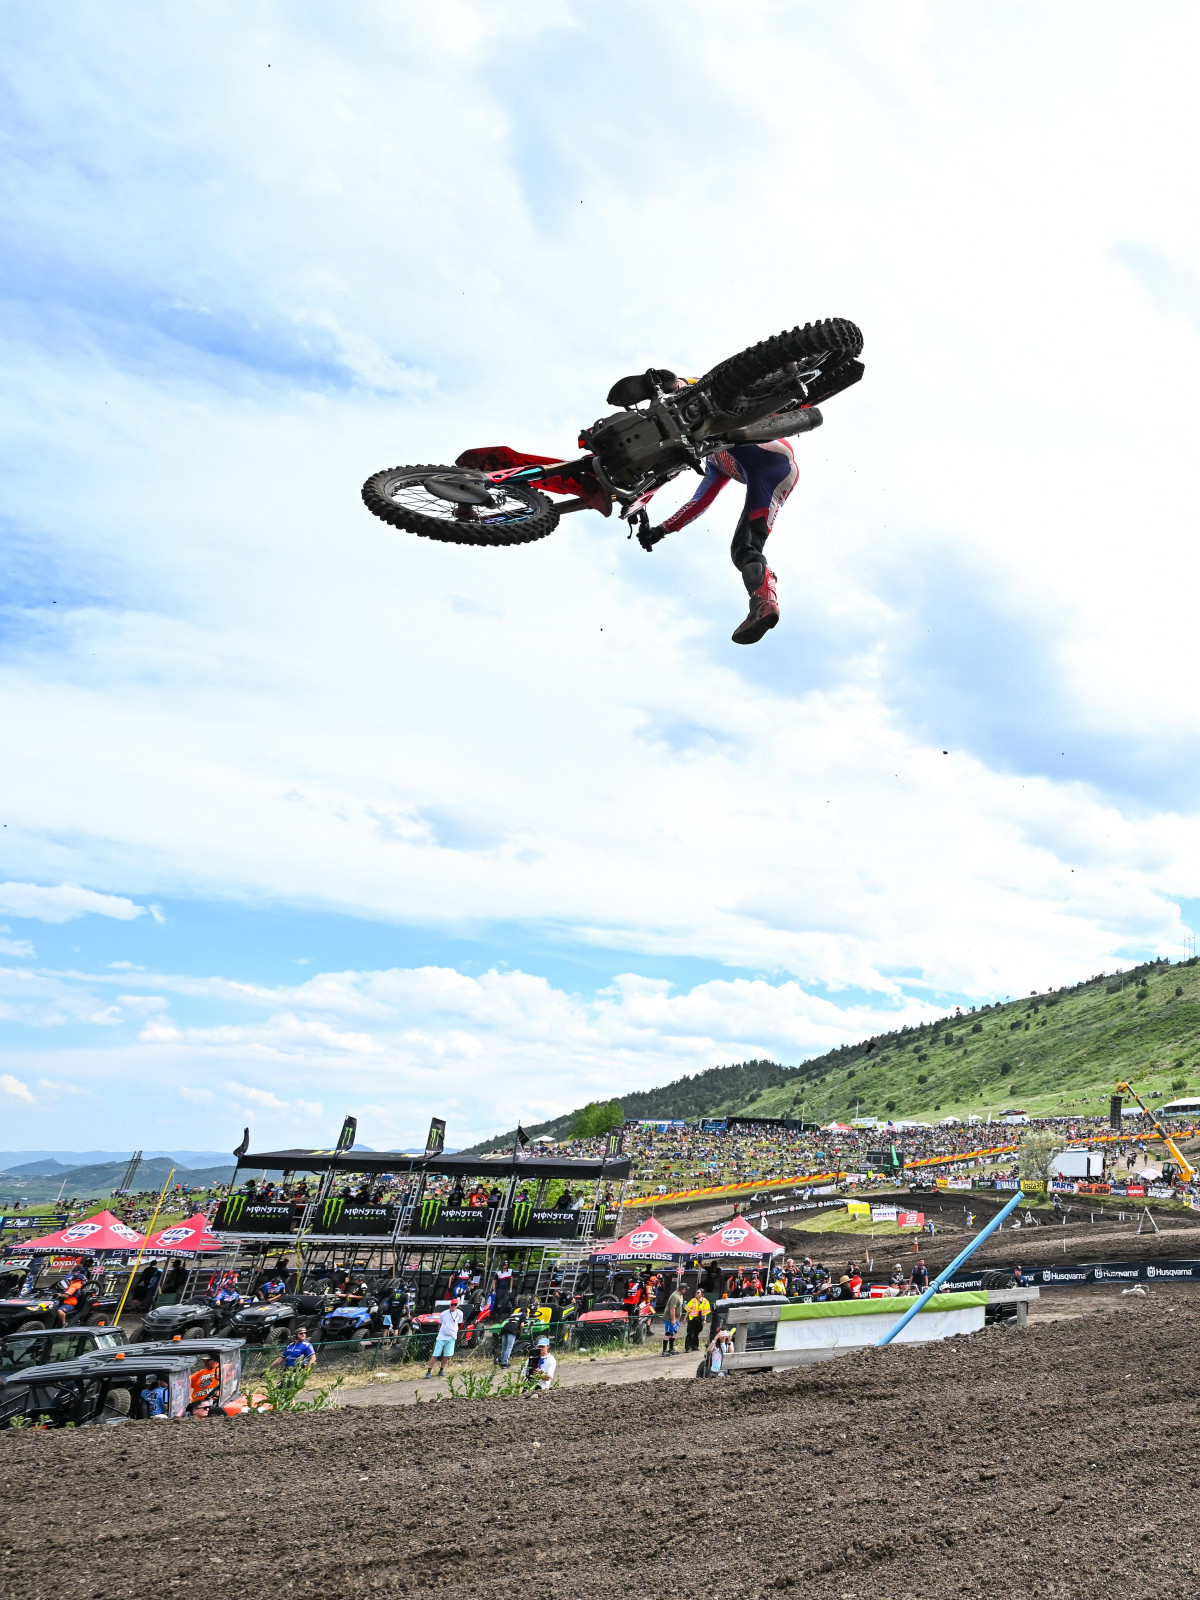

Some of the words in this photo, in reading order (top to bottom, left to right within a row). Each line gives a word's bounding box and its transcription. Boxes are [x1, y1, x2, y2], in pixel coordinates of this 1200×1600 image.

[1052, 1181, 1075, 1190] PARTS
[246, 1205, 289, 1214] MONSTER
[344, 1208, 387, 1216] MONSTER
[441, 1210, 483, 1218] MONSTER
[533, 1212, 574, 1220] MONSTER
[1051, 1272, 1086, 1281] Husqvarna
[1103, 1269, 1139, 1279] Husqvarna
[1156, 1268, 1193, 1278] Husqvarna
